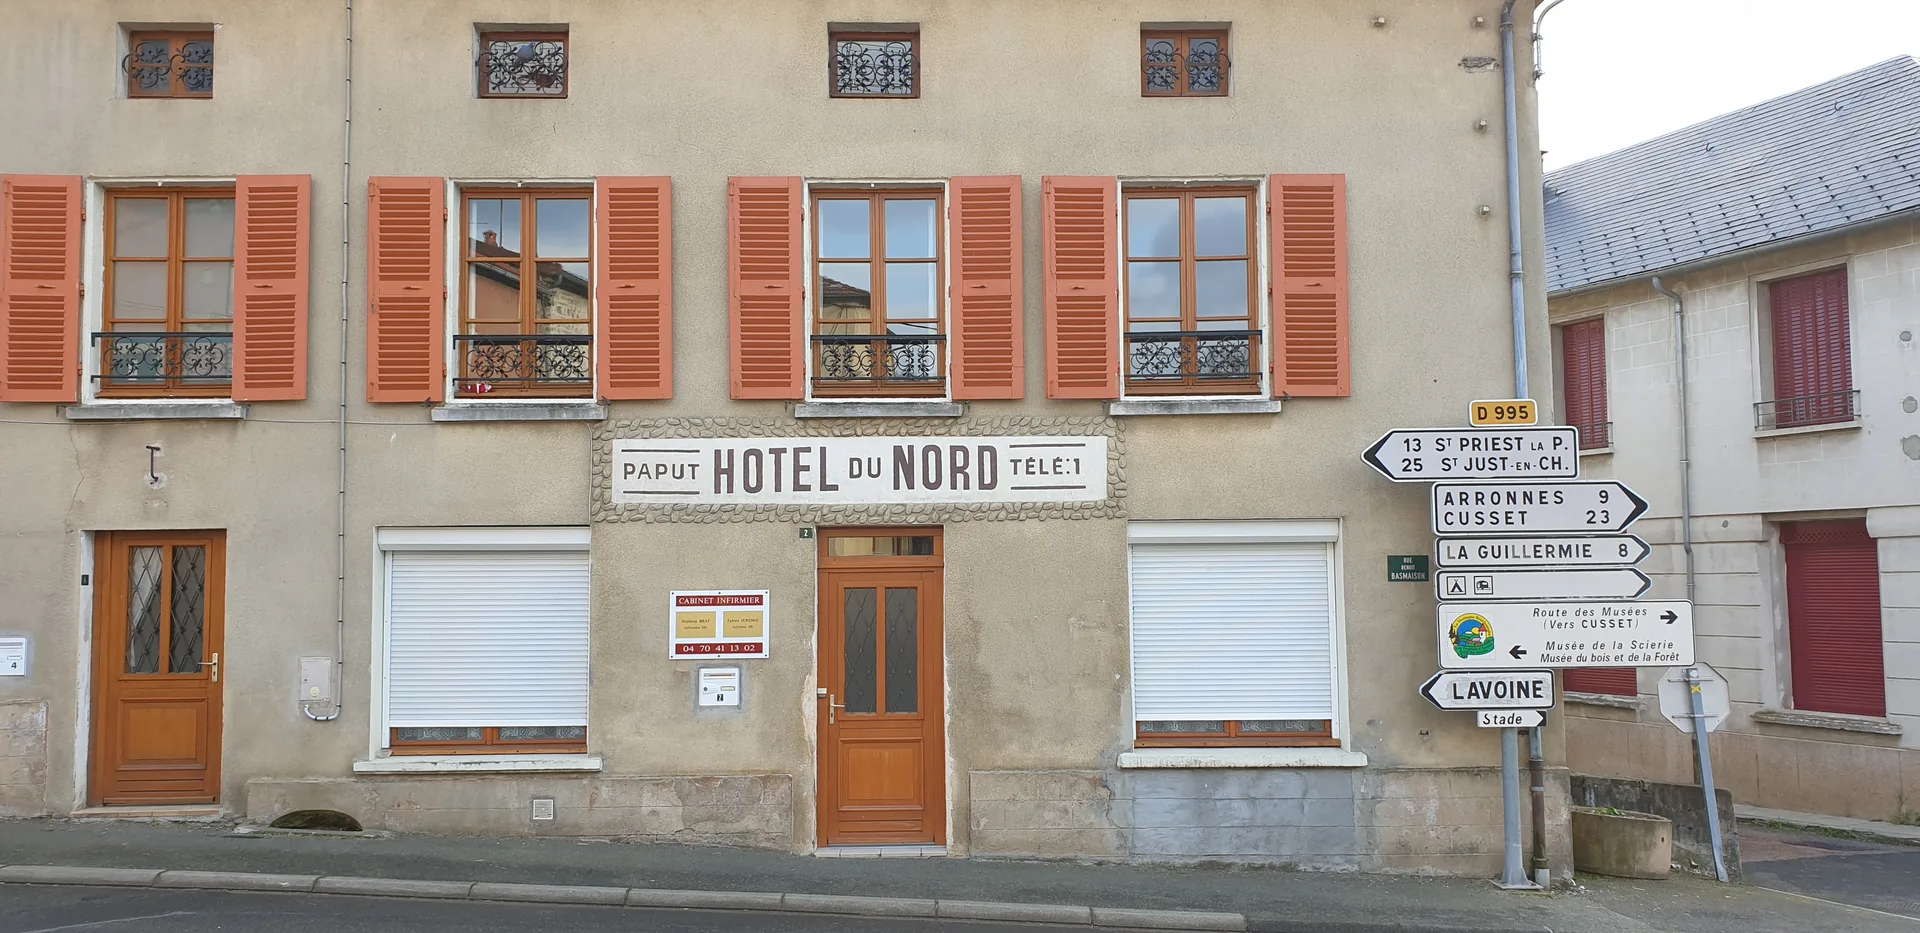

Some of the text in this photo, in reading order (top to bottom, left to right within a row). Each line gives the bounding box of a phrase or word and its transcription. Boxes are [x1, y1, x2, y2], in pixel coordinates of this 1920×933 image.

[1477, 405, 1529, 421] D 995
[1403, 437, 1422, 452] 13
[1460, 436, 1524, 451] PRIEST
[1531, 441, 1544, 451] LA
[1552, 436, 1569, 451] P.
[623, 463, 700, 480] PAPUT
[713, 446, 839, 494] HOTEL
[849, 457, 882, 479] DU
[892, 444, 998, 491] NORD
[1401, 458, 1423, 472] 25
[1443, 489, 1609, 506] ARRONNES 9
[1444, 509, 1610, 526] CUSSET 23
[803, 528, 809, 537] 2
[1446, 543, 1629, 560] LA GUILLERMIE 8
[1391, 572, 1426, 580] BASMAISON
[717, 596, 760, 604] INFIRMIER
[1532, 606, 1648, 617] Route des Musées
[1543, 618, 1639, 630] (Vers CUSSET)
[730, 644, 740, 652] 13
[743, 644, 756, 652] 02
[1545, 640, 1674, 651] Musée de la Scierie
[1540, 651, 1680, 663] Musée du bois et de la Forêt
[1452, 680, 1545, 700] LAVOINE
[1482, 712, 1523, 726] Stade
